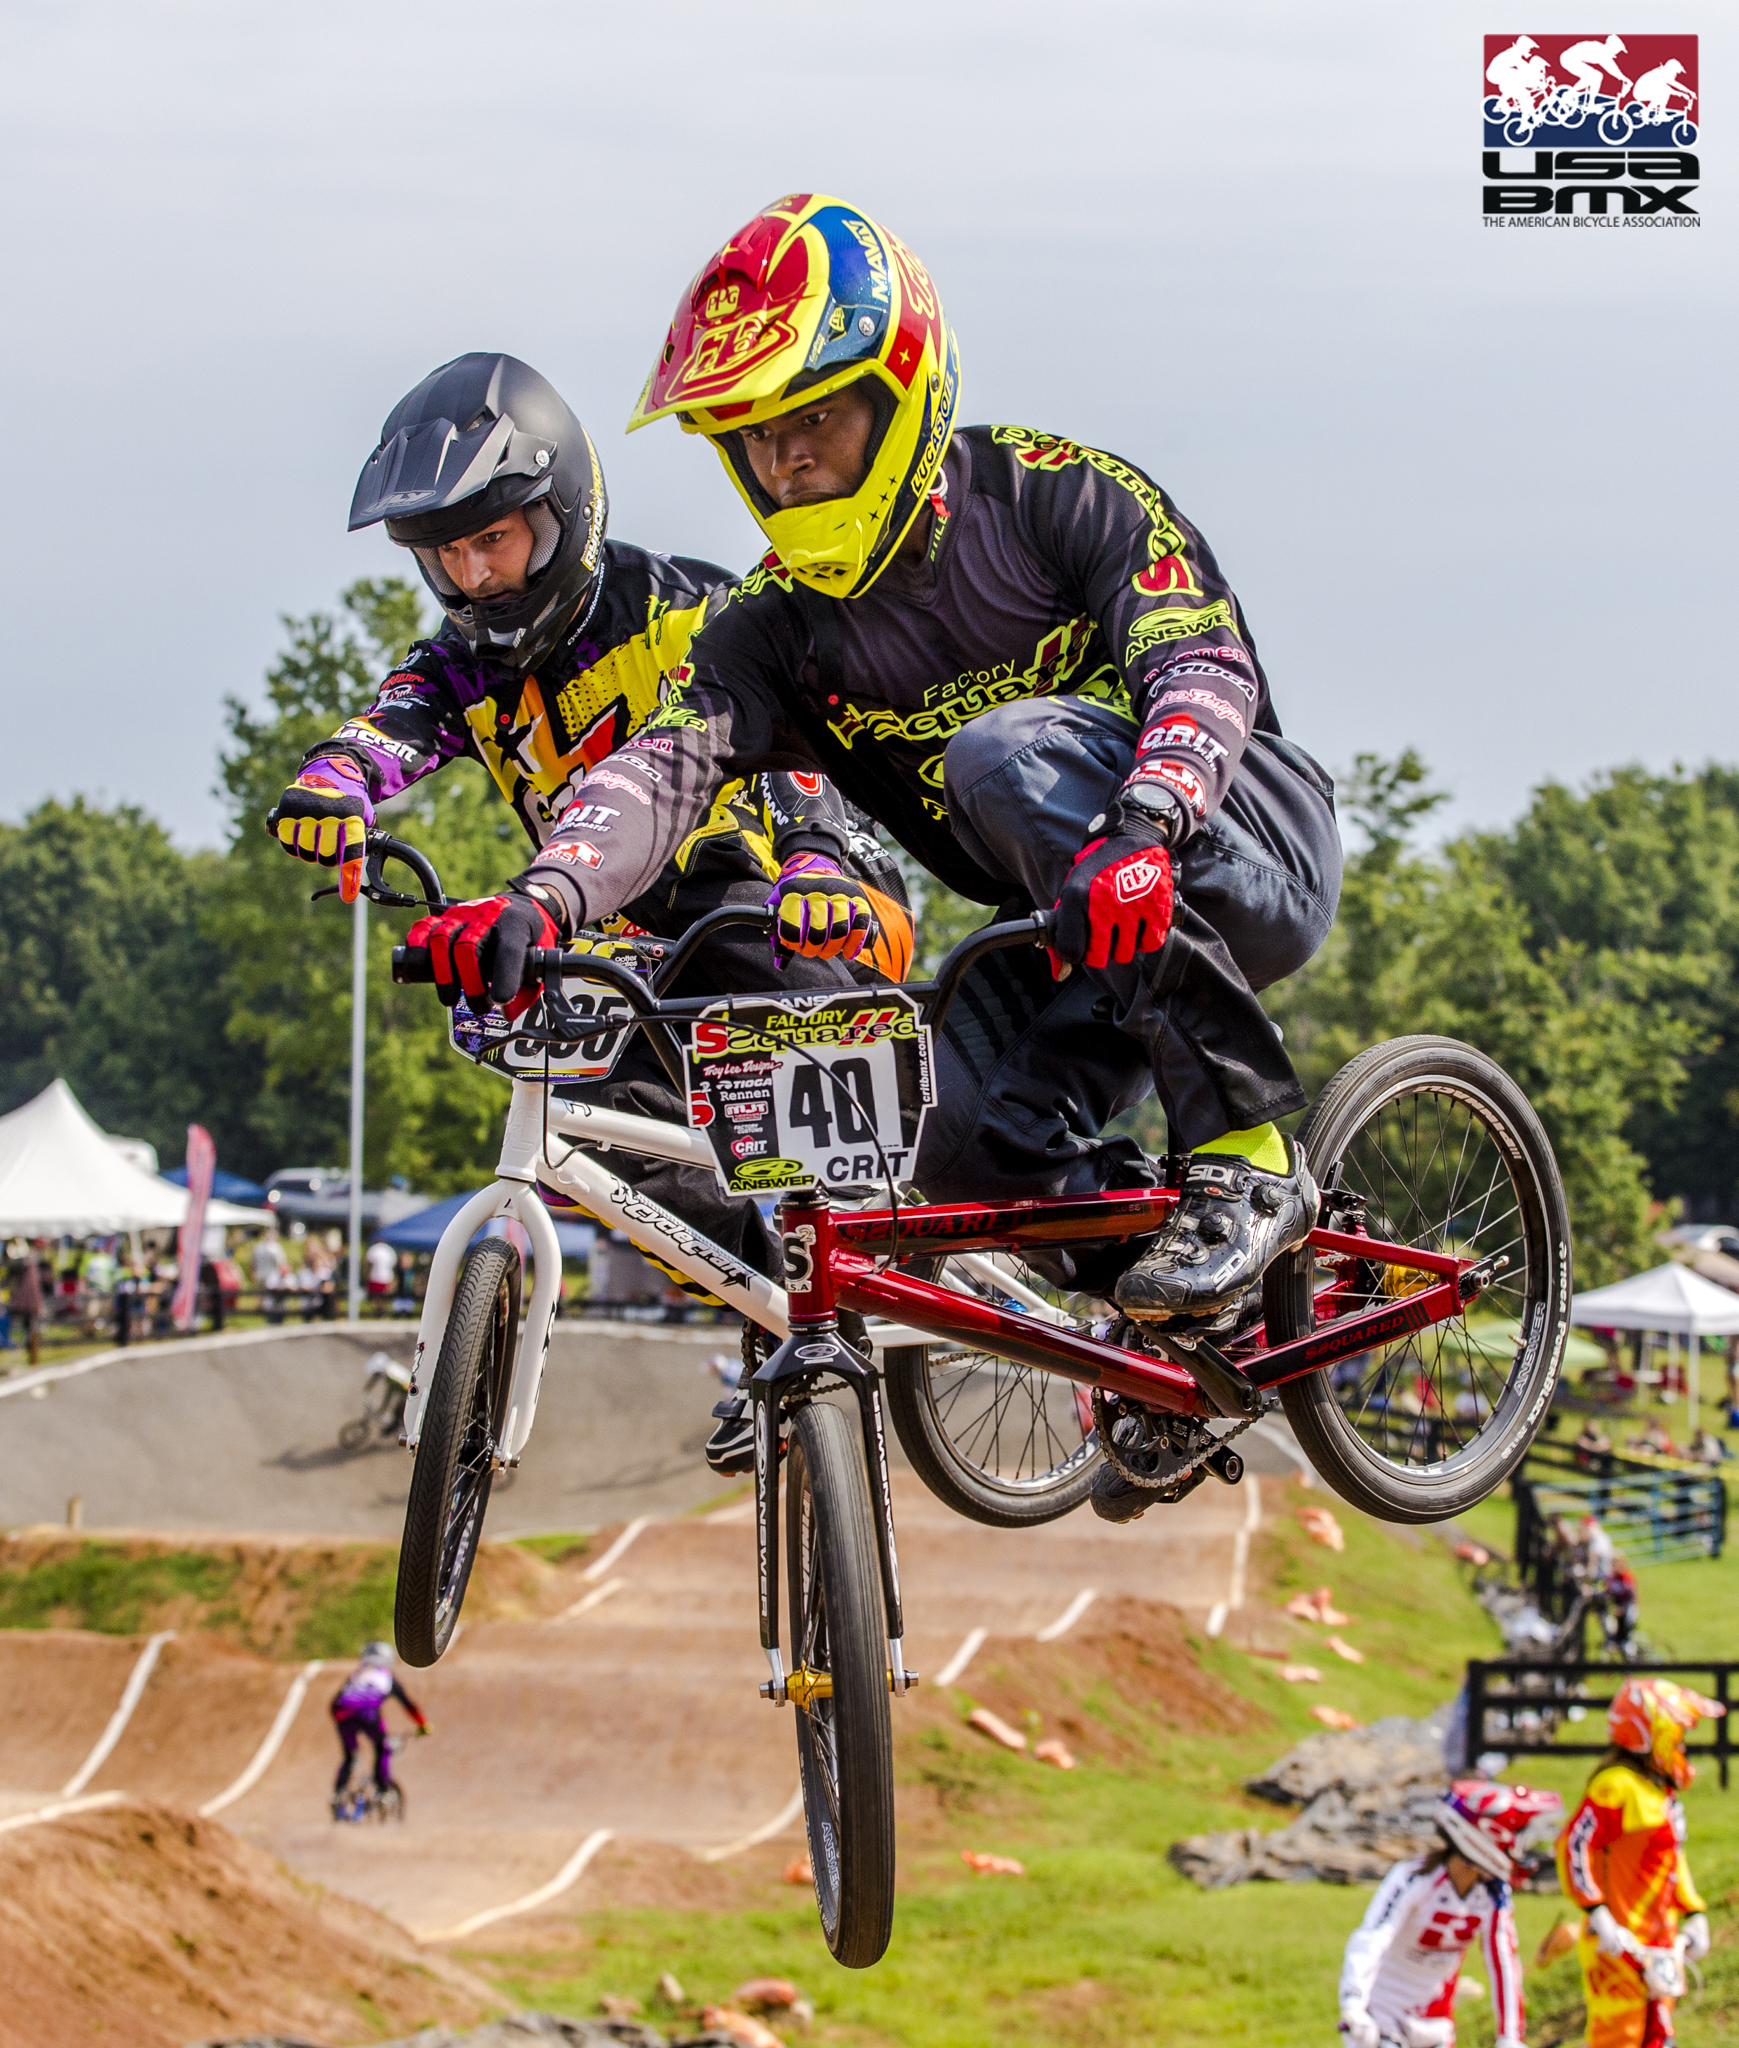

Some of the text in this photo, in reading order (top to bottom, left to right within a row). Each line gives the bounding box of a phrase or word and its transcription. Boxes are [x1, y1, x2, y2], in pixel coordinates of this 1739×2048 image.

[707, 287, 738, 312] PPG
[911, 415, 947, 498] LUCAS
[923, 659, 1016, 708] Factory
[1174, 662, 1257, 702] TIOGA
[560, 805, 622, 826] RIT
[765, 1009, 848, 1029] FACTORY
[702, 1059, 784, 1080] Troy Lee Designs
[733, 1078, 773, 1090] TIOGA
[720, 1089, 771, 1102] Rennen
[788, 1057, 879, 1149] 40
[735, 1139, 768, 1154] CRIT
[826, 1151, 909, 1182] CRIT
[729, 1174, 815, 1193] ANSWER
[1513, 1301, 1547, 1397] ANSWER
[872, 1390, 893, 1528] ANSWER
[757, 1480, 768, 1618] ANSWER
[822, 1821, 840, 1892] ANSWER
